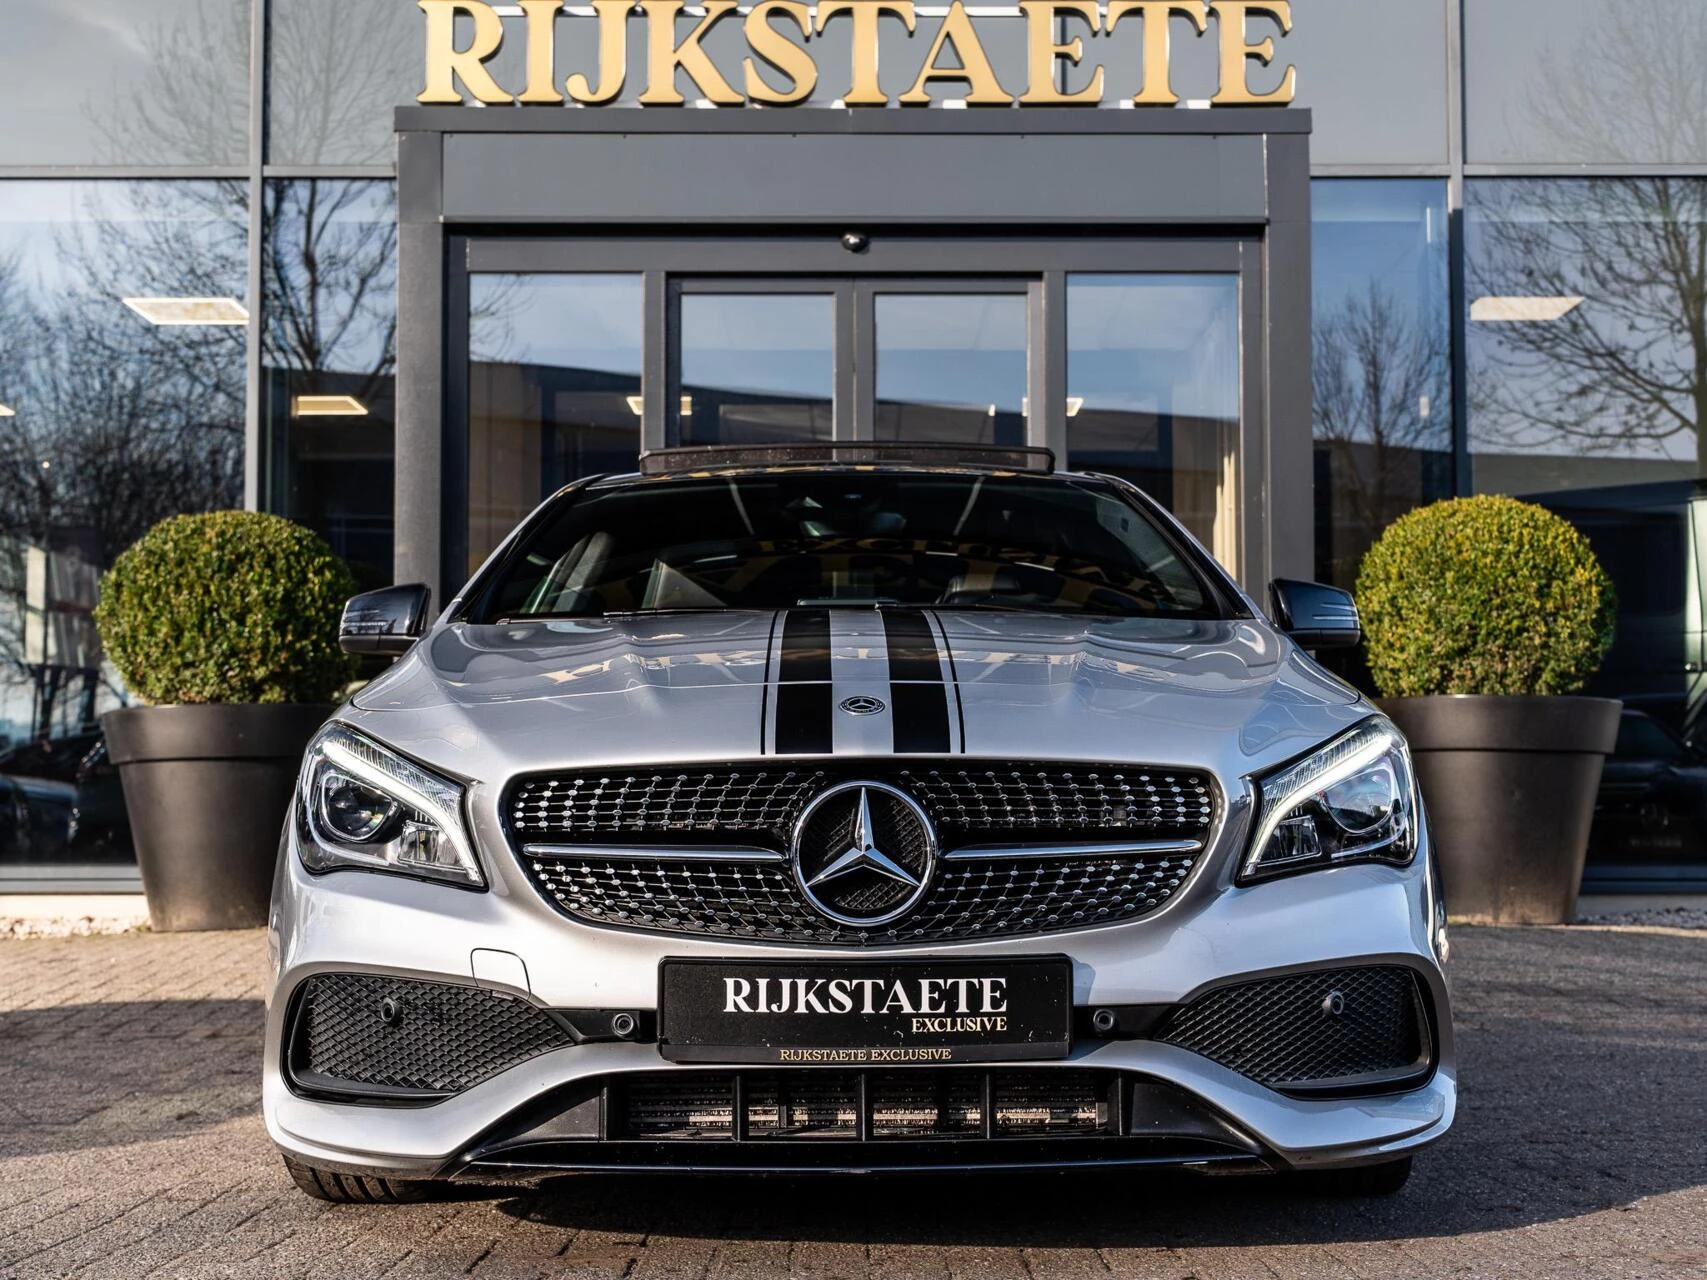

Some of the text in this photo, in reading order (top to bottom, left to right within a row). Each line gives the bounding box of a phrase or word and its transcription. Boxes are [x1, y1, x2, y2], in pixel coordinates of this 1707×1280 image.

[416, 0, 1296, 105] RIJKSTAETE
[723, 977, 1007, 1014] RIJKSTAETE
[911, 1017, 1007, 1032] EXCLUSIVE
[779, 1048, 952, 1061] RIJKSTAETE EXCLUSIVE
